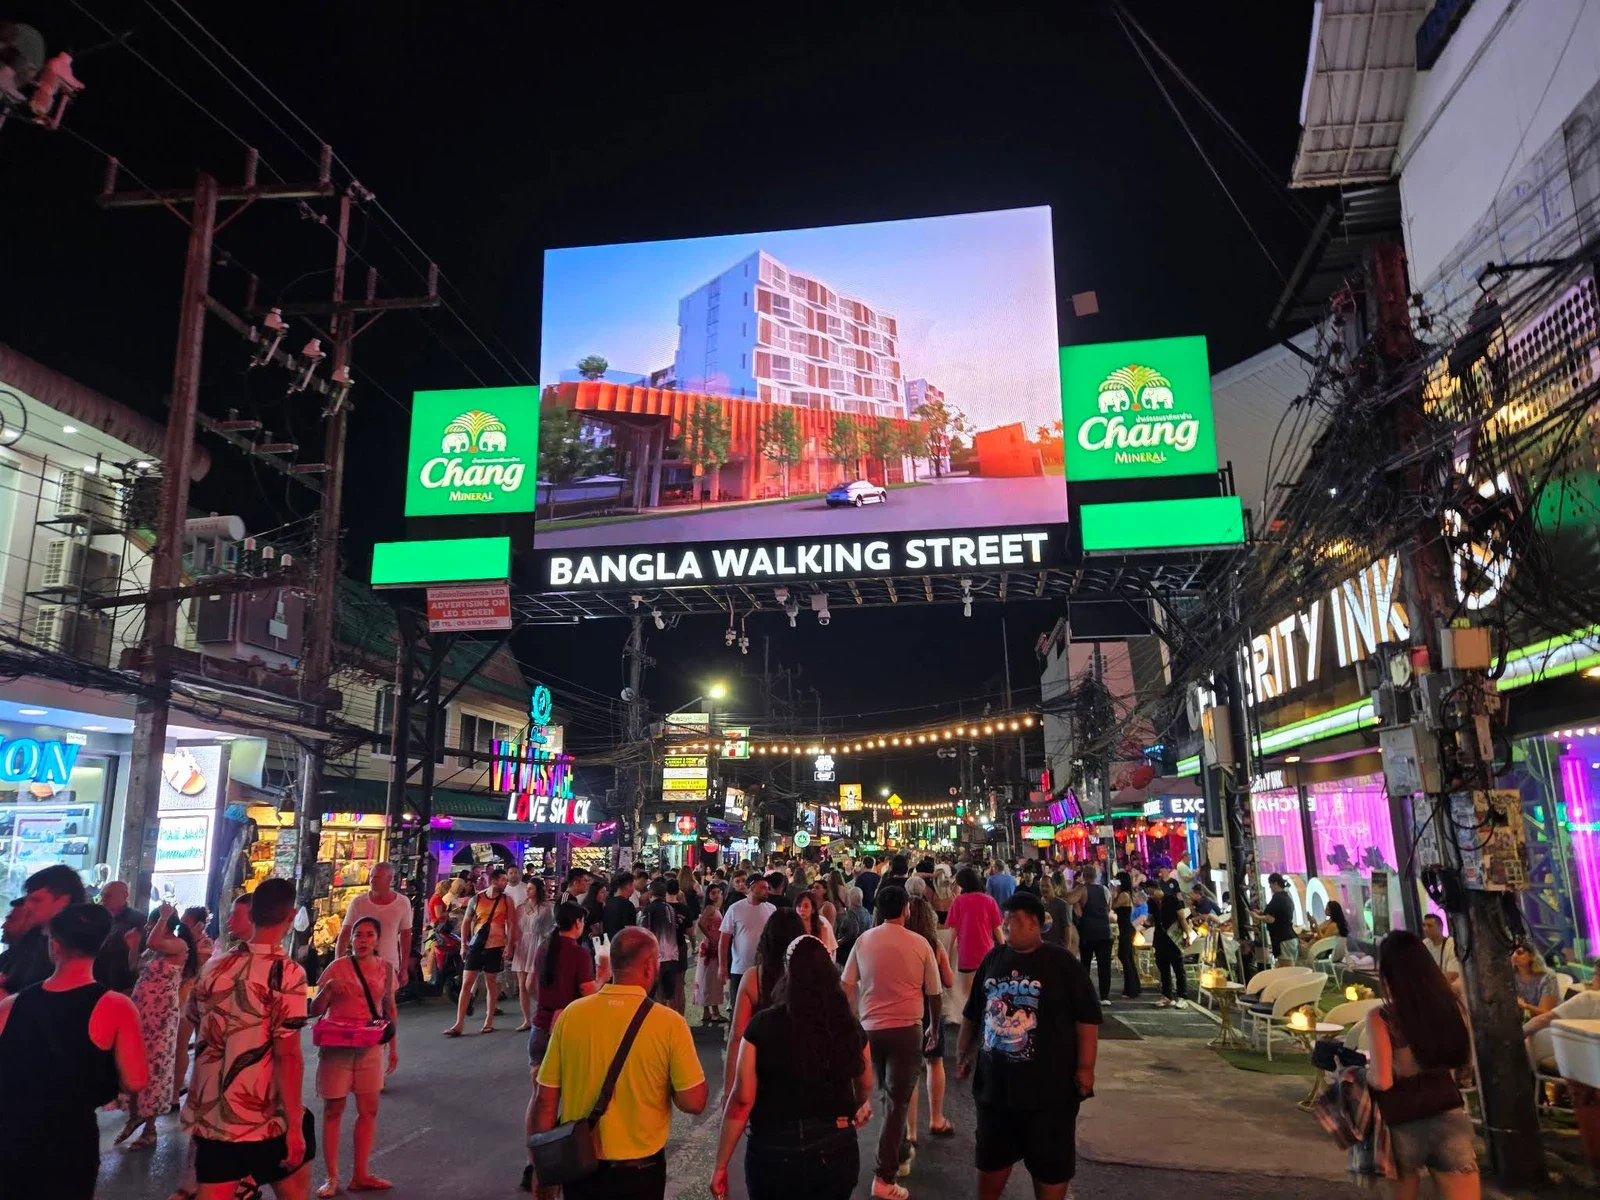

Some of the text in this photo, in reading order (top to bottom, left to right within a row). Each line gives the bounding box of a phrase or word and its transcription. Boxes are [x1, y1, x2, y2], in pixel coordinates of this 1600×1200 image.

[1078, 416, 1199, 451] Chang
[420, 458, 525, 491] Chang
[549, 532, 1049, 586] BANGLA WALKING STREET
[431, 599, 506, 609] ADVERTISING ON
[442, 608, 495, 618] LED SCREEN
[1331, 553, 1411, 668] INK
[0, 734, 81, 785] ON
[518, 742, 576, 800] MASSAGE
[507, 792, 591, 824] LOVE SHACK
[1171, 798, 1205, 814] EXC
